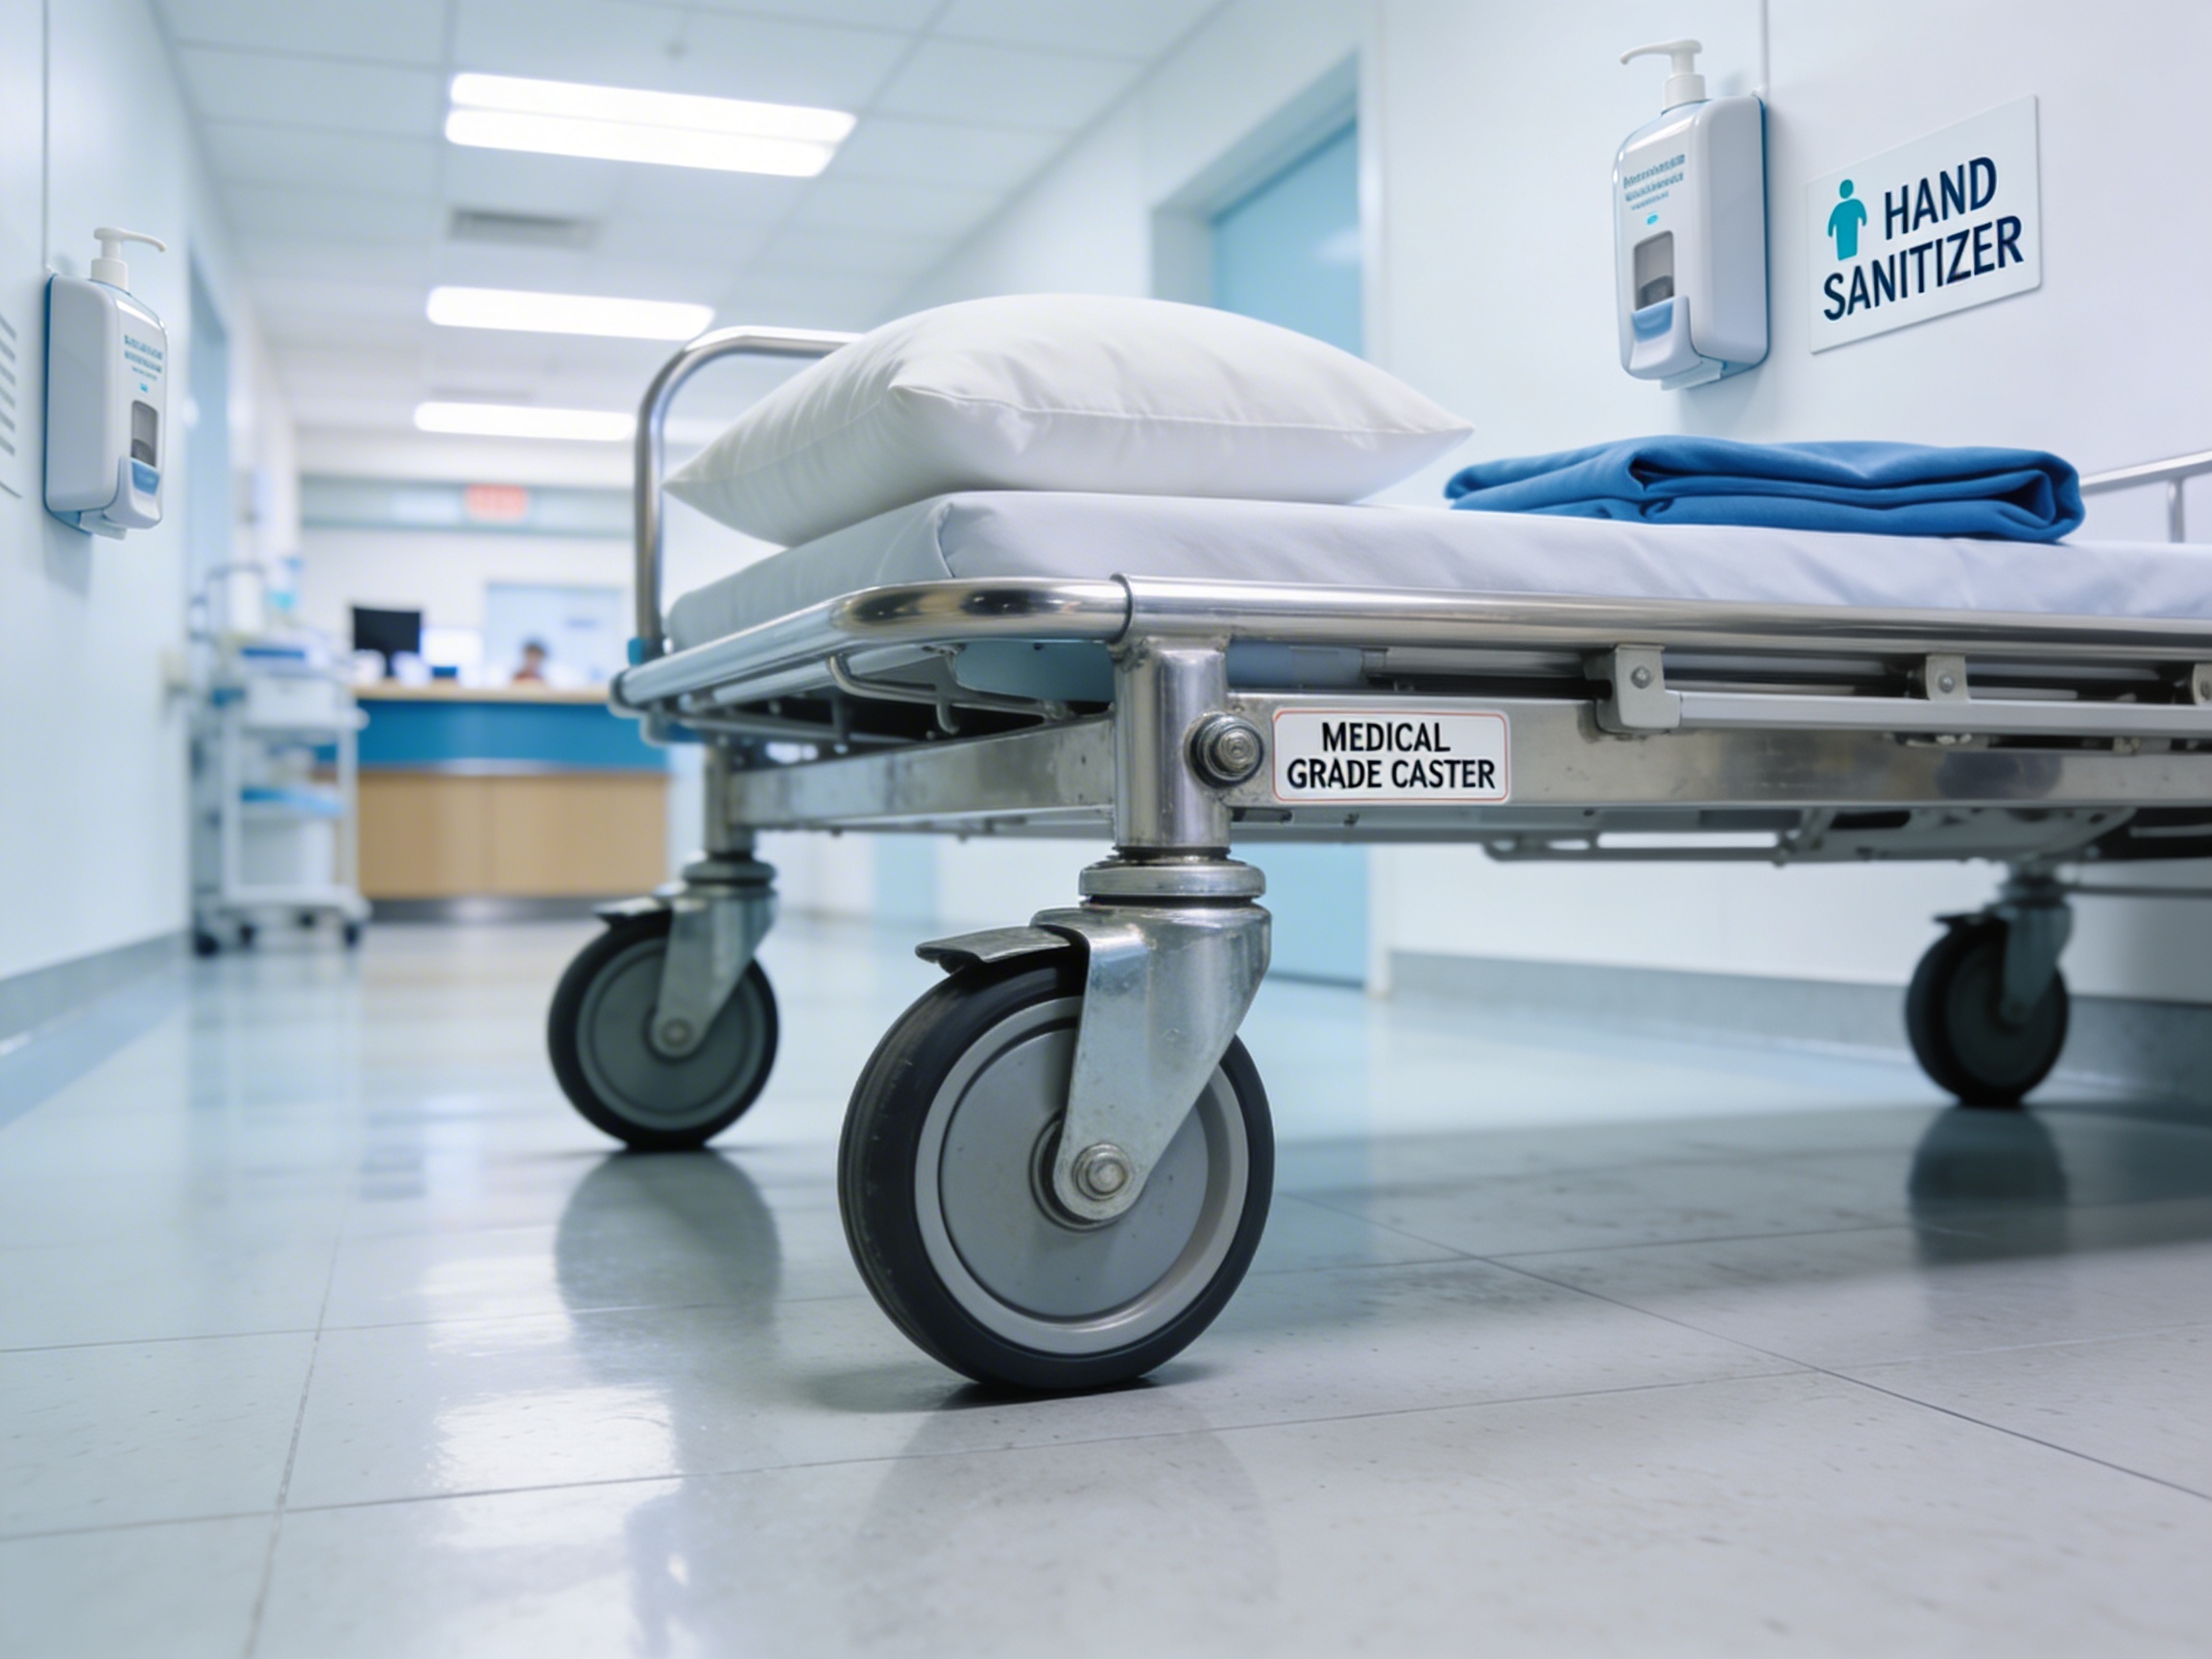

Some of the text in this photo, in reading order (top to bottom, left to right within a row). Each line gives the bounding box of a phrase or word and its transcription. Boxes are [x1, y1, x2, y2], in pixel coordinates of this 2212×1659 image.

[1884, 156, 1998, 241] HAND
[1823, 214, 2025, 322] SANITIZER
[1321, 721, 1452, 754] MEDICAL
[1286, 757, 1496, 790] GRADE CASTER
